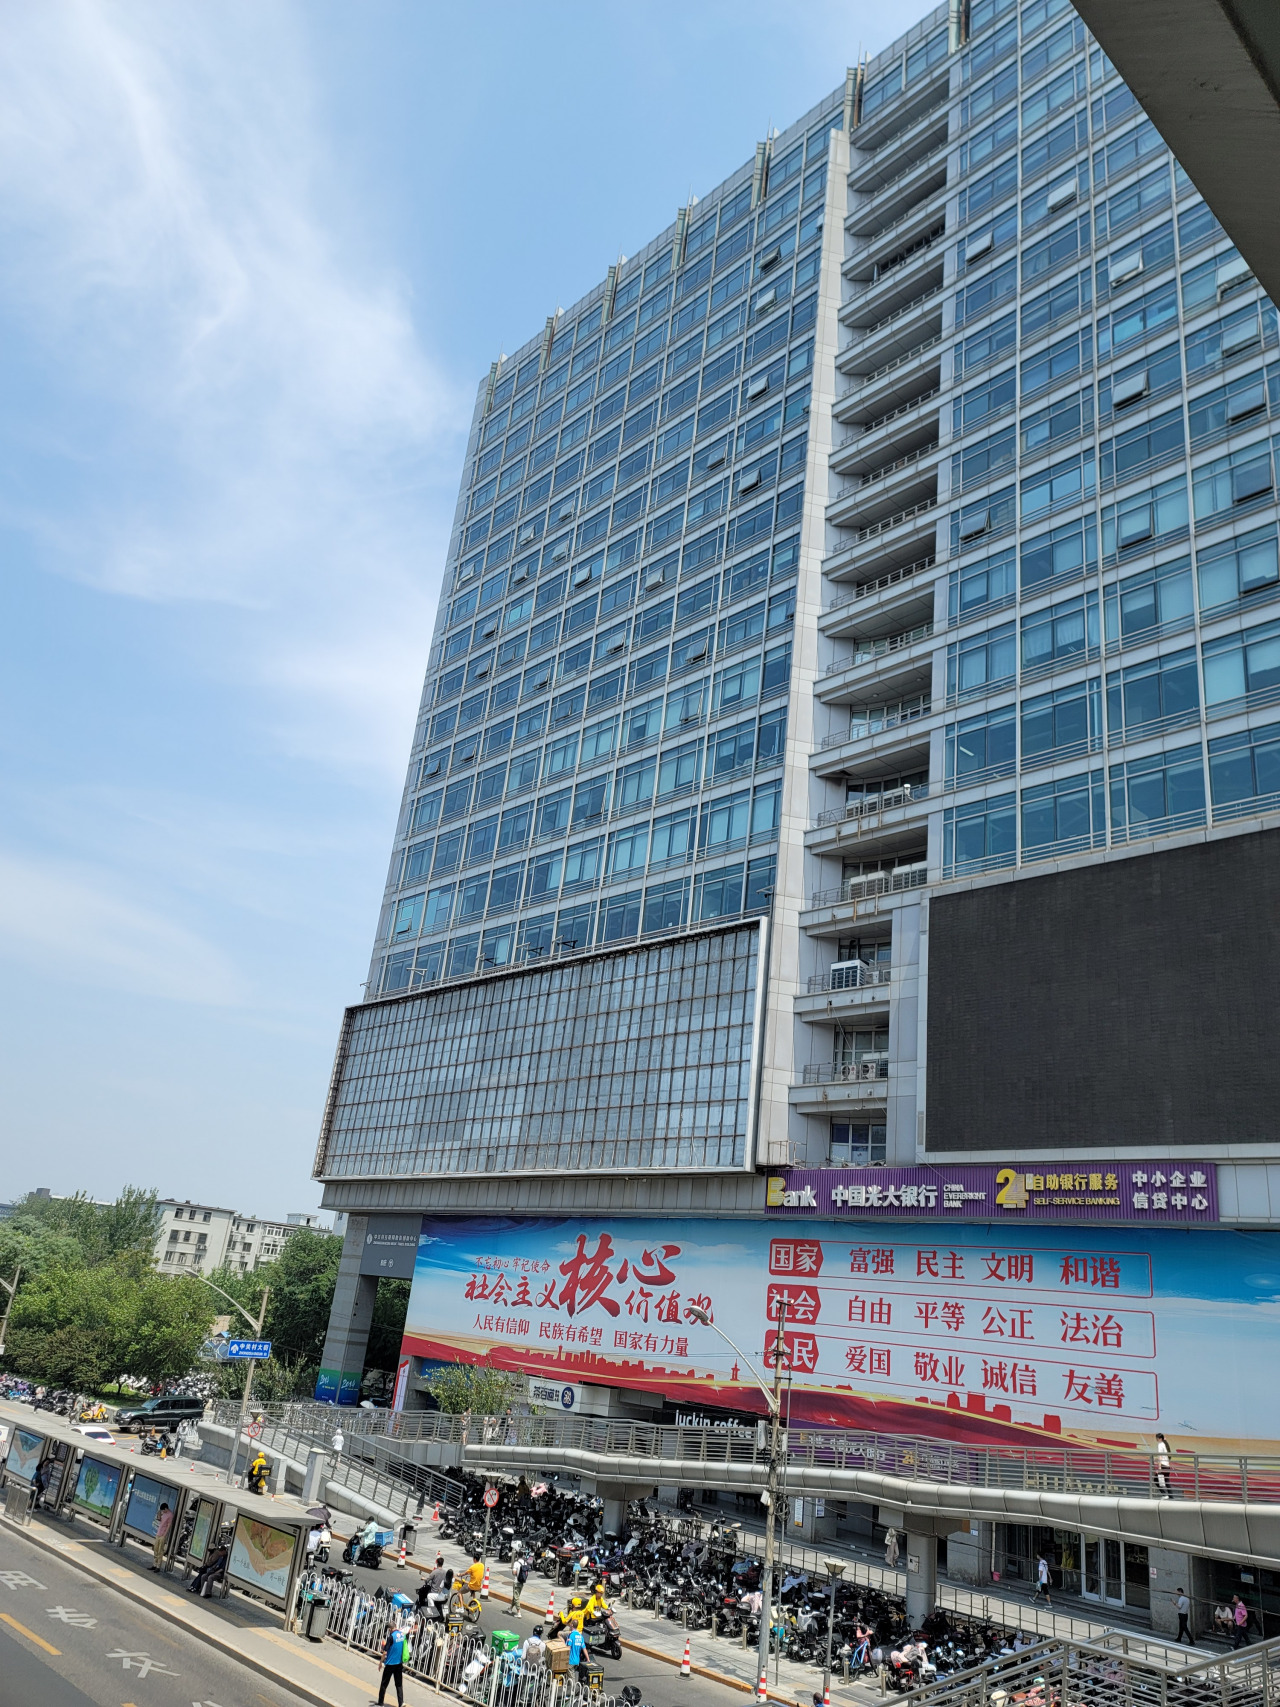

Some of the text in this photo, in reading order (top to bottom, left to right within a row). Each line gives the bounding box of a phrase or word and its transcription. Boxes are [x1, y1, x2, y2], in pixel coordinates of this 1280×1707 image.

[943, 1184, 964, 1192] CHINA
[995, 1168, 1029, 1209] 24
[1033, 1173, 1119, 1191] 自助银行服务
[1132, 1170, 1208, 1188] 中小企业
[766, 1176, 817, 1207] Bank
[831, 1184, 938, 1207] 中国光大银行
[943, 1192, 987, 1200] EVERBRIGHT
[1033, 1197, 1120, 1206] SELF-SERVICE BANKING
[1132, 1192, 1209, 1210] 信贷中心
[943, 1200, 963, 1208] BANK
[475, 1256, 551, 1275] 不忘初心 牢记使命
[770, 1243, 1122, 1289] 国家 富强 民主 文明 和谐
[558, 1232, 682, 1320] 核心
[624, 1286, 714, 1327] 价值观
[768, 1288, 1124, 1349] 社会 自由 平等 公正 法治
[472, 1313, 689, 1358] 人民有信仰 民族有希望 国家有力量
[239, 1343, 270, 1352] 中关村大街
[845, 1345, 891, 1377] 爱国
[913, 1351, 966, 1387] 敬业
[980, 1358, 1037, 1397] 诚信
[1062, 1368, 1126, 1409] 友善
